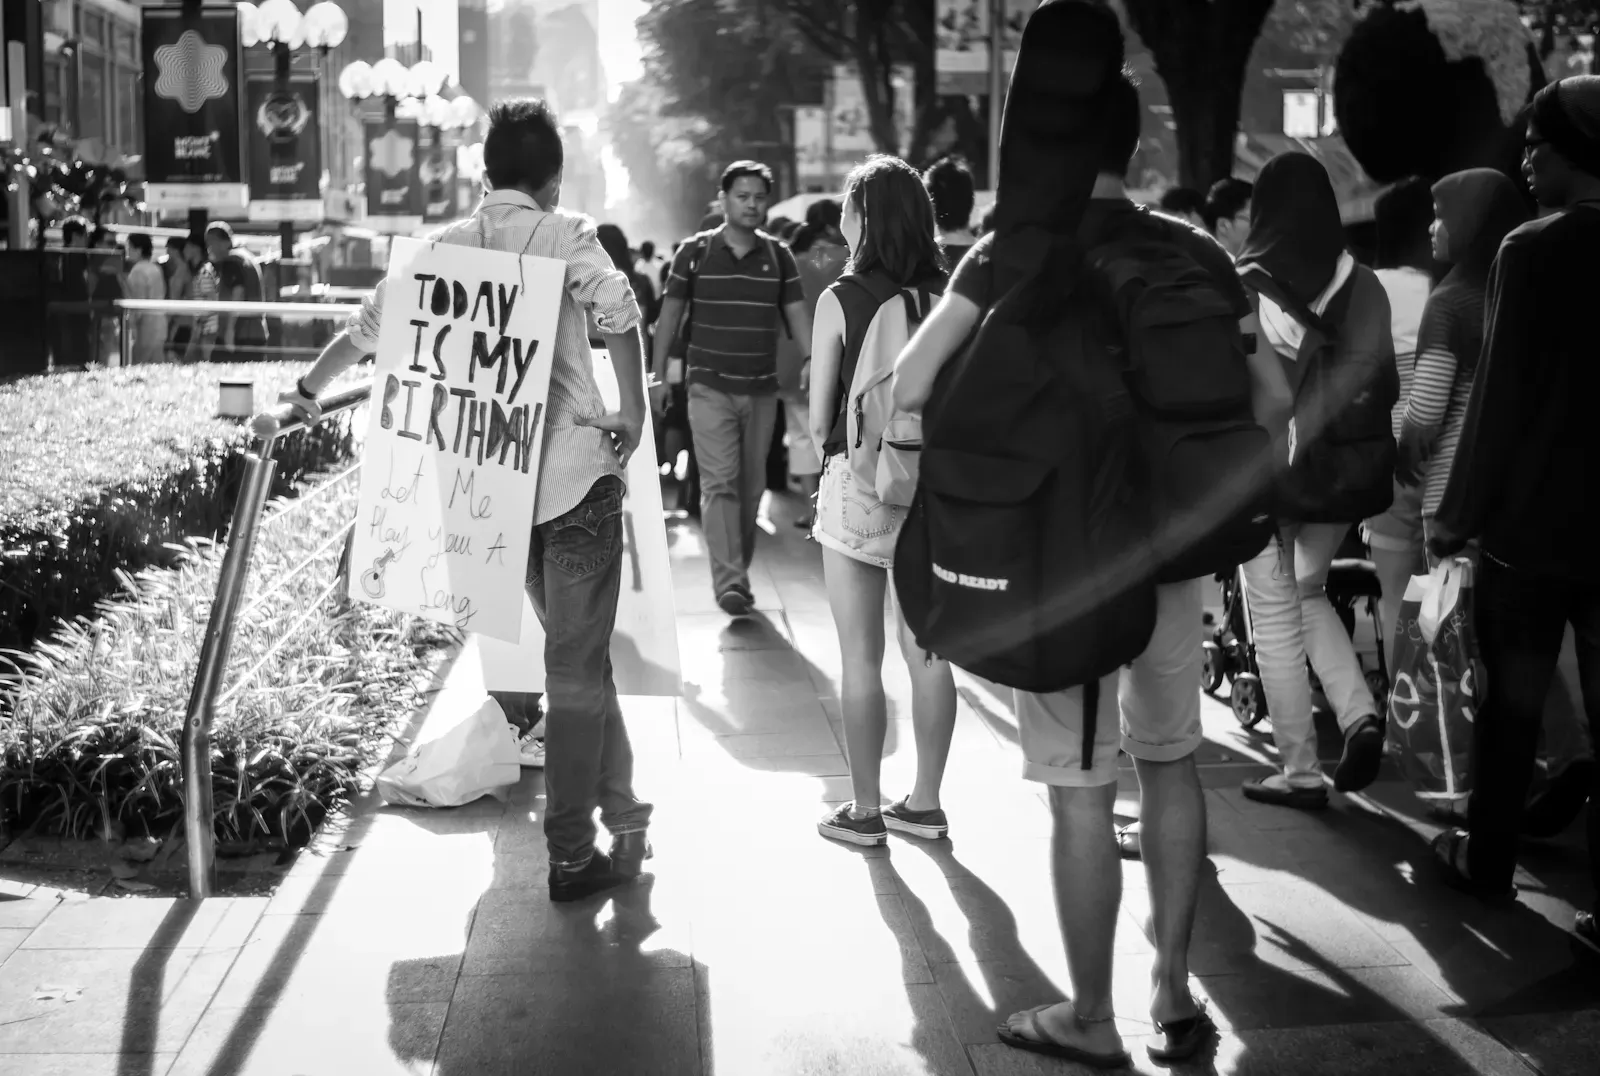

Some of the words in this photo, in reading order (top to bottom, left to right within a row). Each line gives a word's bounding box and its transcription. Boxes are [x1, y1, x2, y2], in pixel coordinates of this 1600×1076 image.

[414, 273, 519, 336] TODAY
[408, 319, 452, 381] IS
[468, 330, 540, 405] MY
[380, 373, 543, 475] BIRTHDAY
[381, 444, 425, 505] Let
[448, 467, 493, 520] Me
[485, 532, 508, 566] A
[958, 573, 1009, 591] READY
